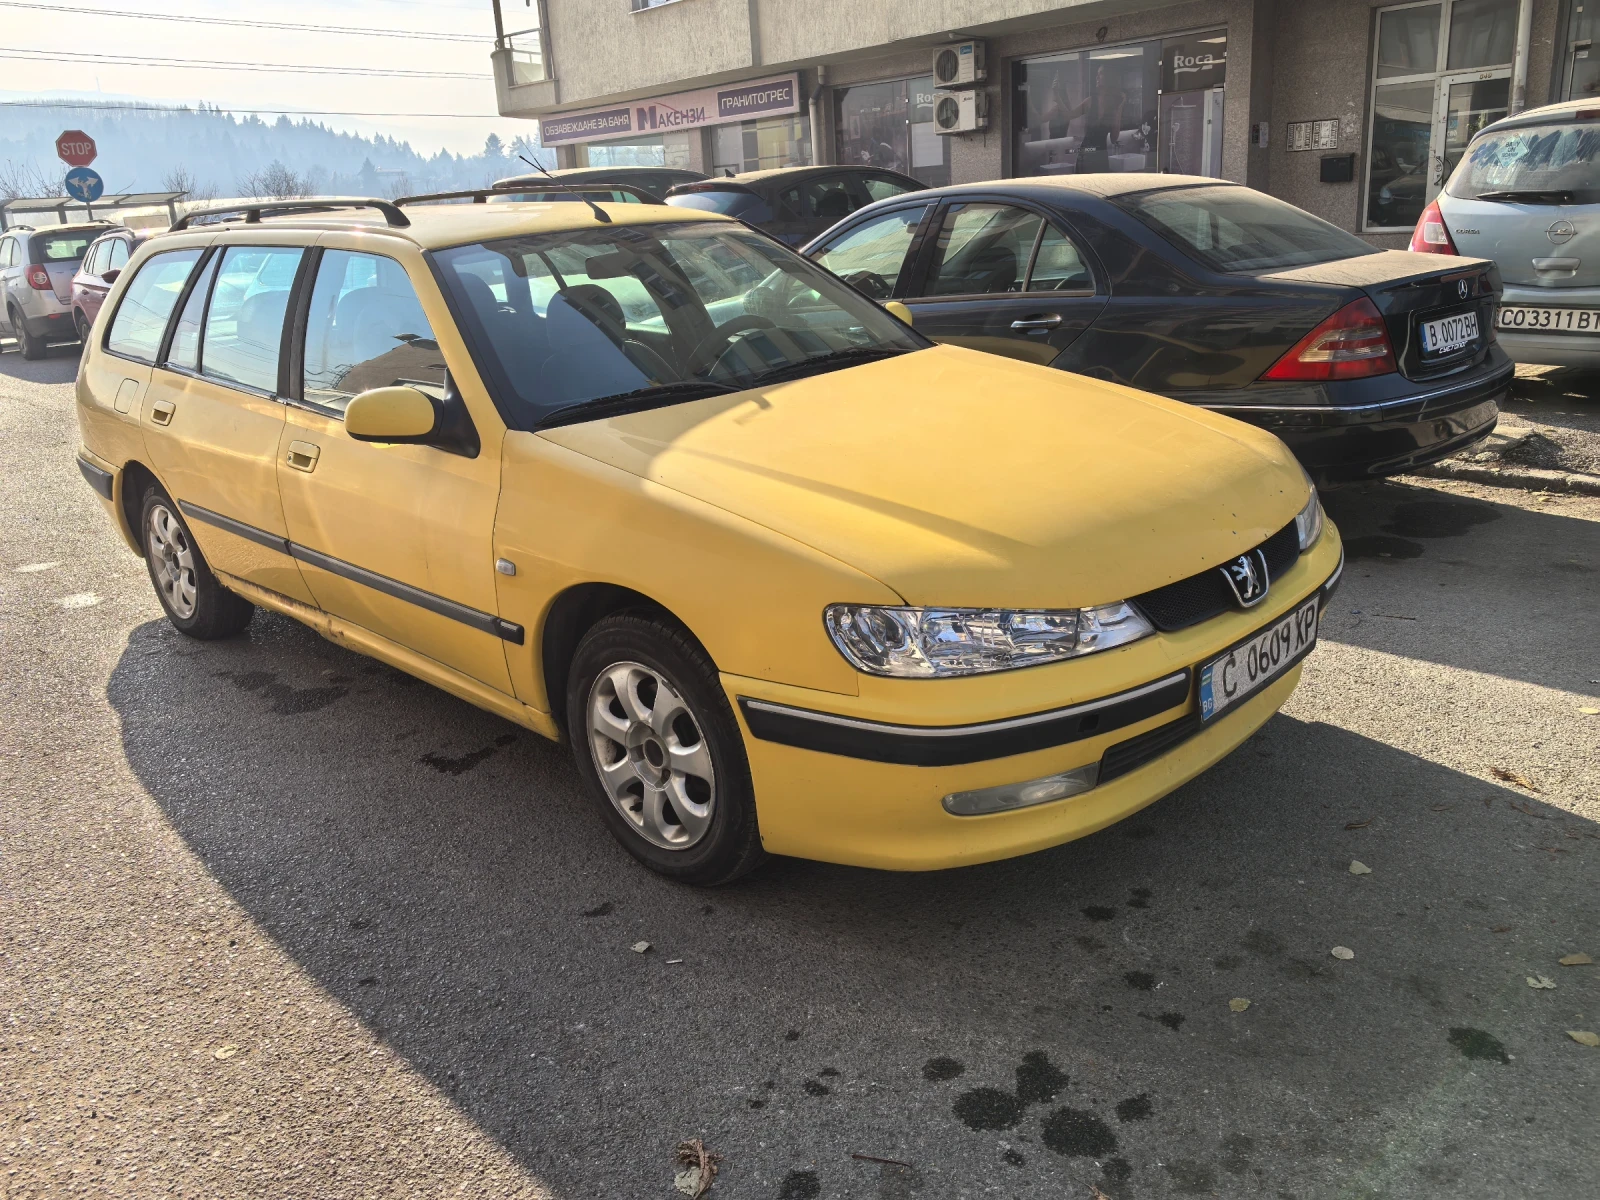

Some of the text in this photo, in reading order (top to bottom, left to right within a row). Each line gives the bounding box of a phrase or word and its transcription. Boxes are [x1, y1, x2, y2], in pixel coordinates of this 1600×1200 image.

[1174, 54, 1213, 68] Roca
[721, 88, 789, 110] ГРАНИТОГРЕС
[916, 92, 936, 104] Roc
[544, 115, 630, 136] ОБЗАВЕЖДАНЕ ЗА БАНЯ
[61, 142, 92, 156] STOP
[1202, 700, 1213, 713] BG
